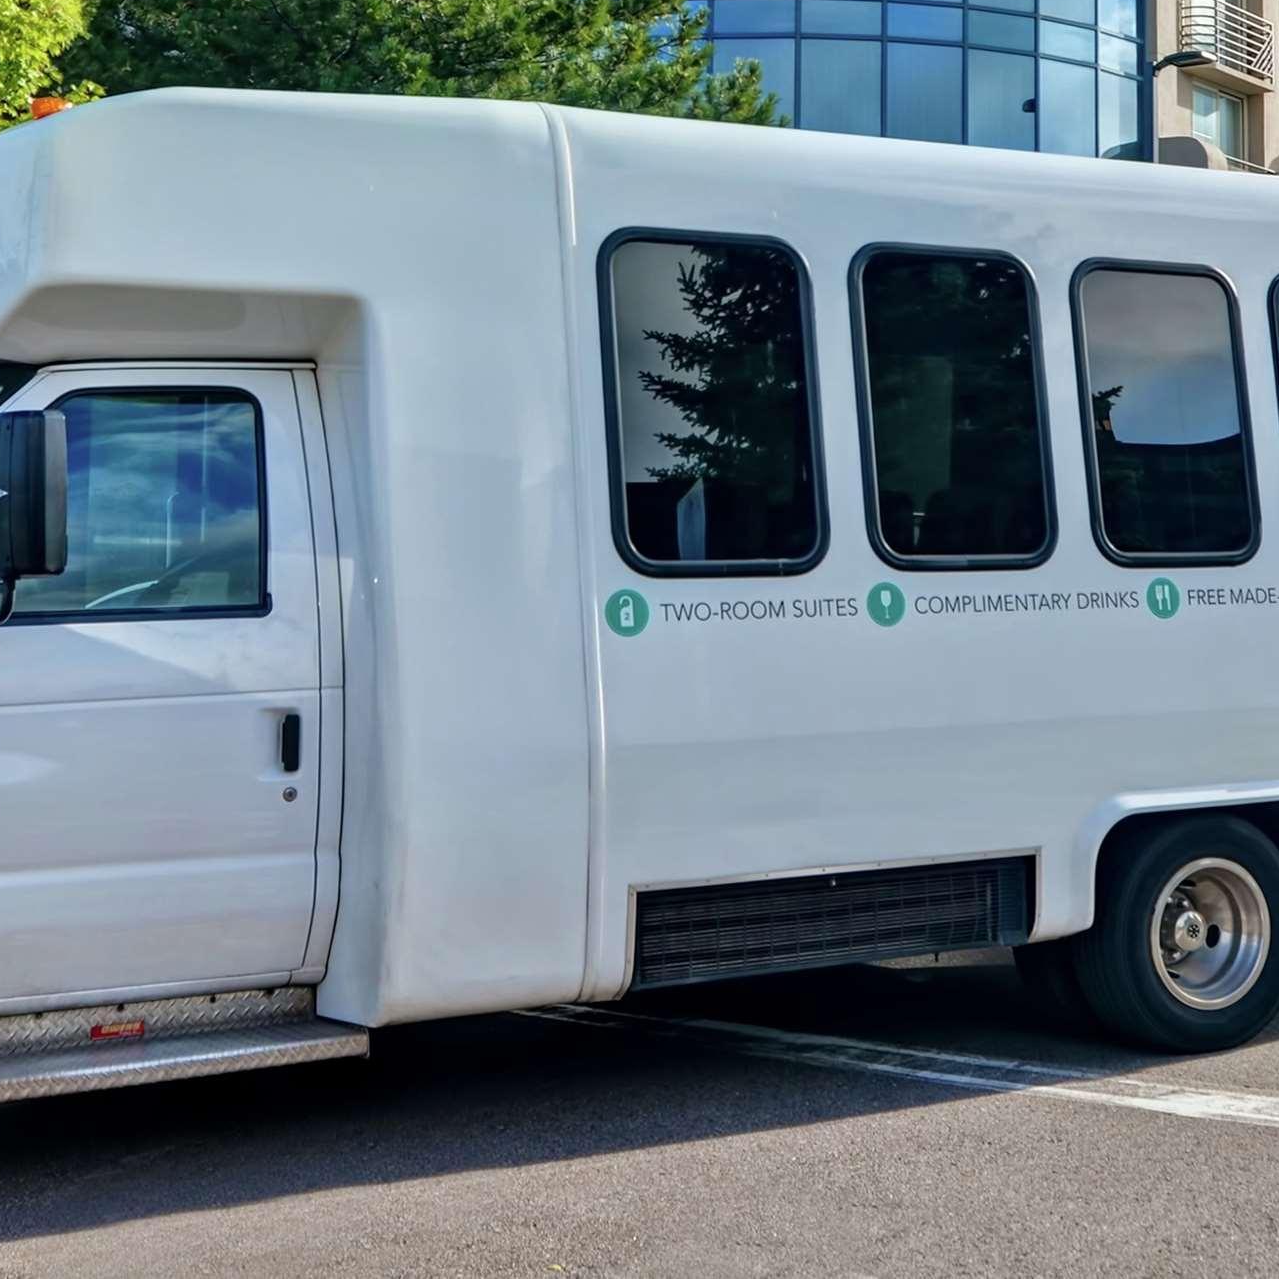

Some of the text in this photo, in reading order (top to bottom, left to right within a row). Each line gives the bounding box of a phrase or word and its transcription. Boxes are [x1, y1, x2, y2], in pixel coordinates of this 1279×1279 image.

[914, 590, 1140, 614] COMPLIMENTARY DRINKS
[1186, 588, 1227, 606] FREE
[659, 597, 858, 622] TWO-ROOM SUITES
